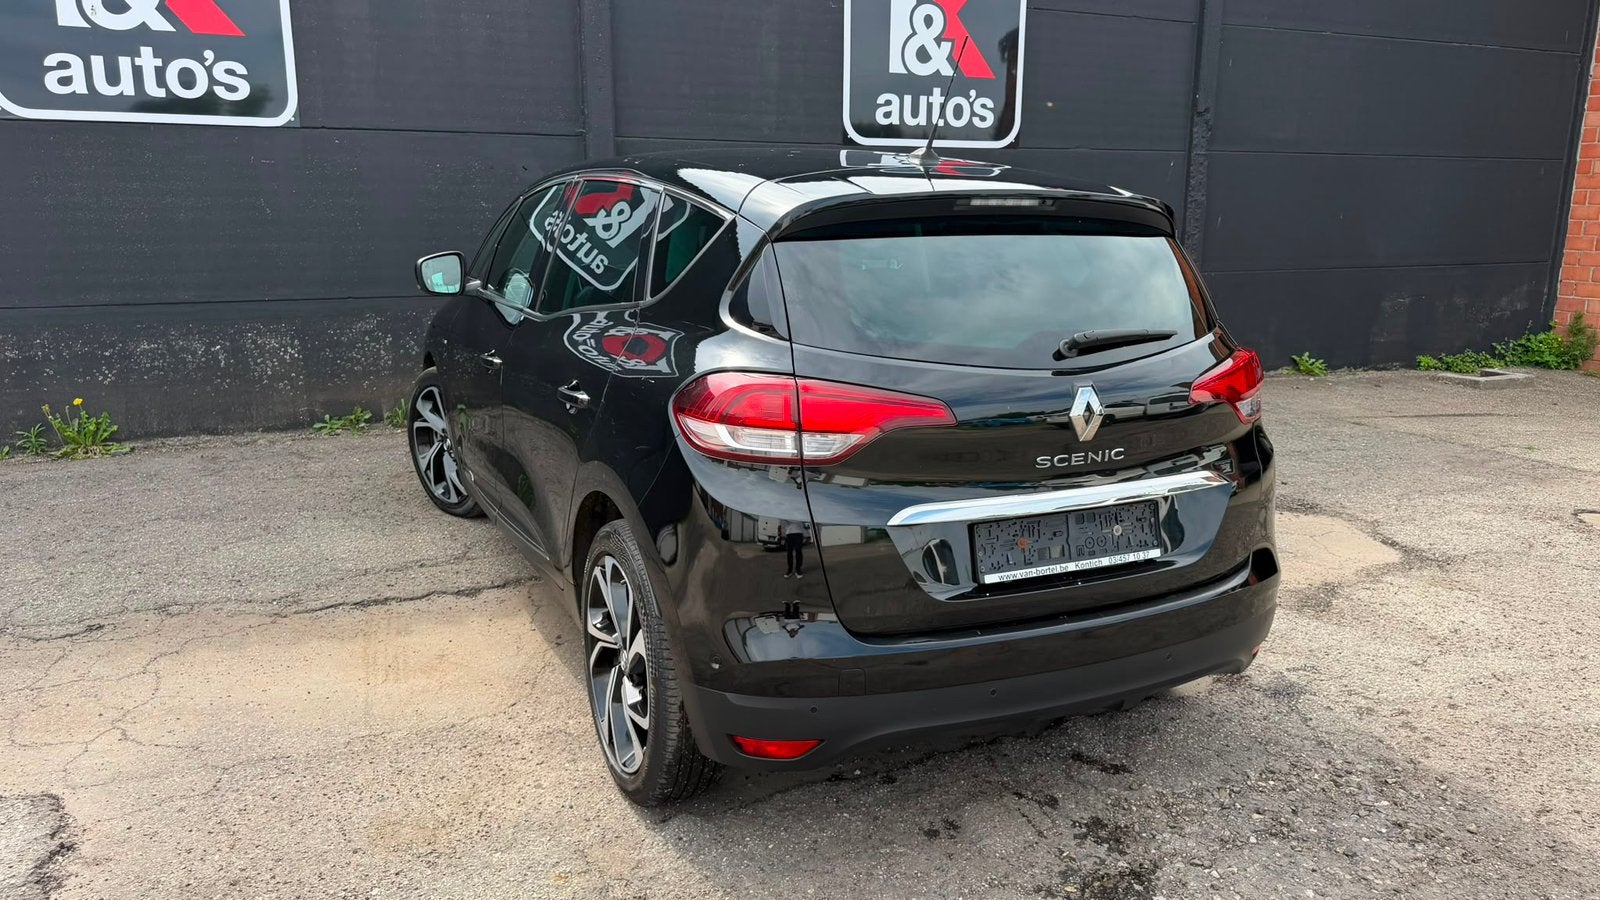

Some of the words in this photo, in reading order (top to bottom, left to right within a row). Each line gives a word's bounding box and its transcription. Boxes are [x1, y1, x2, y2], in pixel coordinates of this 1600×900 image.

[43, 46, 250, 101] auto's
[875, 87, 995, 129] auto's
[1035, 447, 1125, 469] SCENIC
[998, 564, 1069, 581] www.van-bortel.be
[1074, 560, 1103, 570] Kontich
